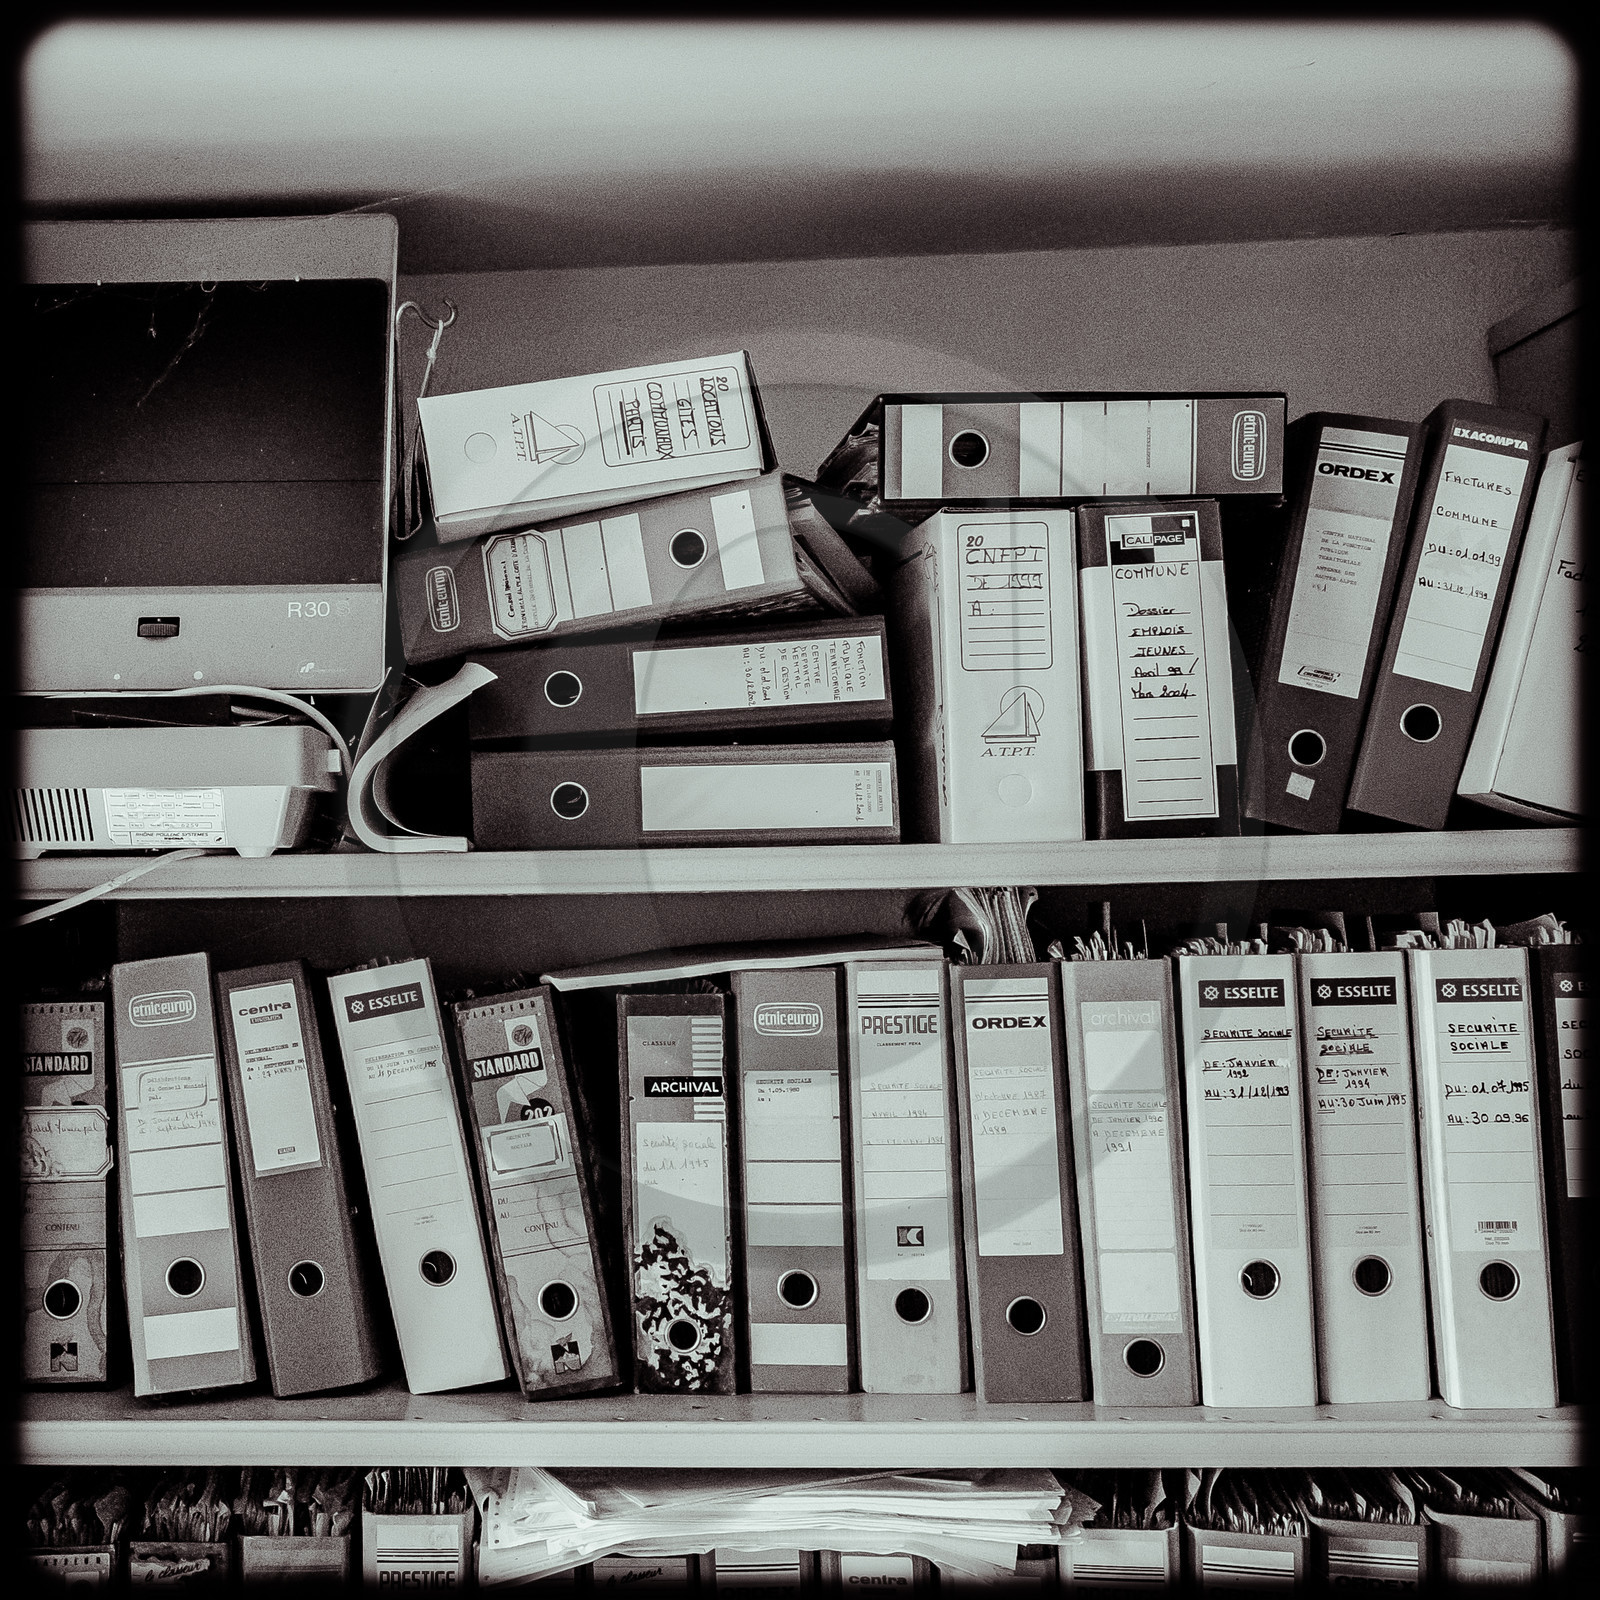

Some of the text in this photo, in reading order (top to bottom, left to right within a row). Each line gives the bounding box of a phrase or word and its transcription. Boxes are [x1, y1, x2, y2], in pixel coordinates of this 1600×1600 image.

[716, 376, 729, 393] 20
[701, 377, 727, 446] LOCATIONS
[646, 382, 675, 460] COMMUNAUX
[511, 412, 527, 462] A.T.P.T.
[1453, 427, 1529, 451] EXACOMPTA
[1318, 462, 1395, 485] ORDEX
[1444, 471, 1512, 496] FACTURES
[1436, 505, 1498, 528] COMMUNE
[967, 536, 983, 547] 20
[1125, 534, 1184, 545] CALIPAGE
[1115, 563, 1190, 580] COMMUNE
[287, 601, 330, 617] R30
[1122, 602, 1176, 616] Dossier
[811, 644, 821, 684] CENTRE
[842, 640, 854, 693] PUBLIQUE
[857, 641, 871, 688] FONCTION
[980, 746, 1036, 757] A.T.P.T.
[1224, 986, 1279, 999] ESSELTE
[1337, 985, 1392, 998] ESSELTE
[1462, 984, 1520, 997] ESSELTE
[238, 1001, 292, 1017] centra
[368, 990, 419, 1011] ESSELTE
[861, 1014, 938, 1035] PRESTIGE
[972, 1015, 1048, 1030] ORDEX
[1091, 1008, 1155, 1026] archival
[1448, 1017, 1518, 1034] SECURITE
[1316, 1025, 1375, 1038] SECURITE
[1450, 1039, 1509, 1051] SOCIALE
[23, 1054, 89, 1073] STANDARD
[473, 1051, 540, 1079] STANDARD
[1225, 1054, 1277, 1068] JANVIER
[1343, 1067, 1389, 1078] JANVIER
[650, 1081, 720, 1094] ARCHIVAL
[500, 1212, 510, 1220] AU
[45, 1223, 80, 1232] CONTENU
[524, 1221, 559, 1234] CONTENU
[379, 1569, 456, 1592] PRESTIGE
[848, 1573, 908, 1587] centra
[1335, 1575, 1417, 1593] ORDEX
